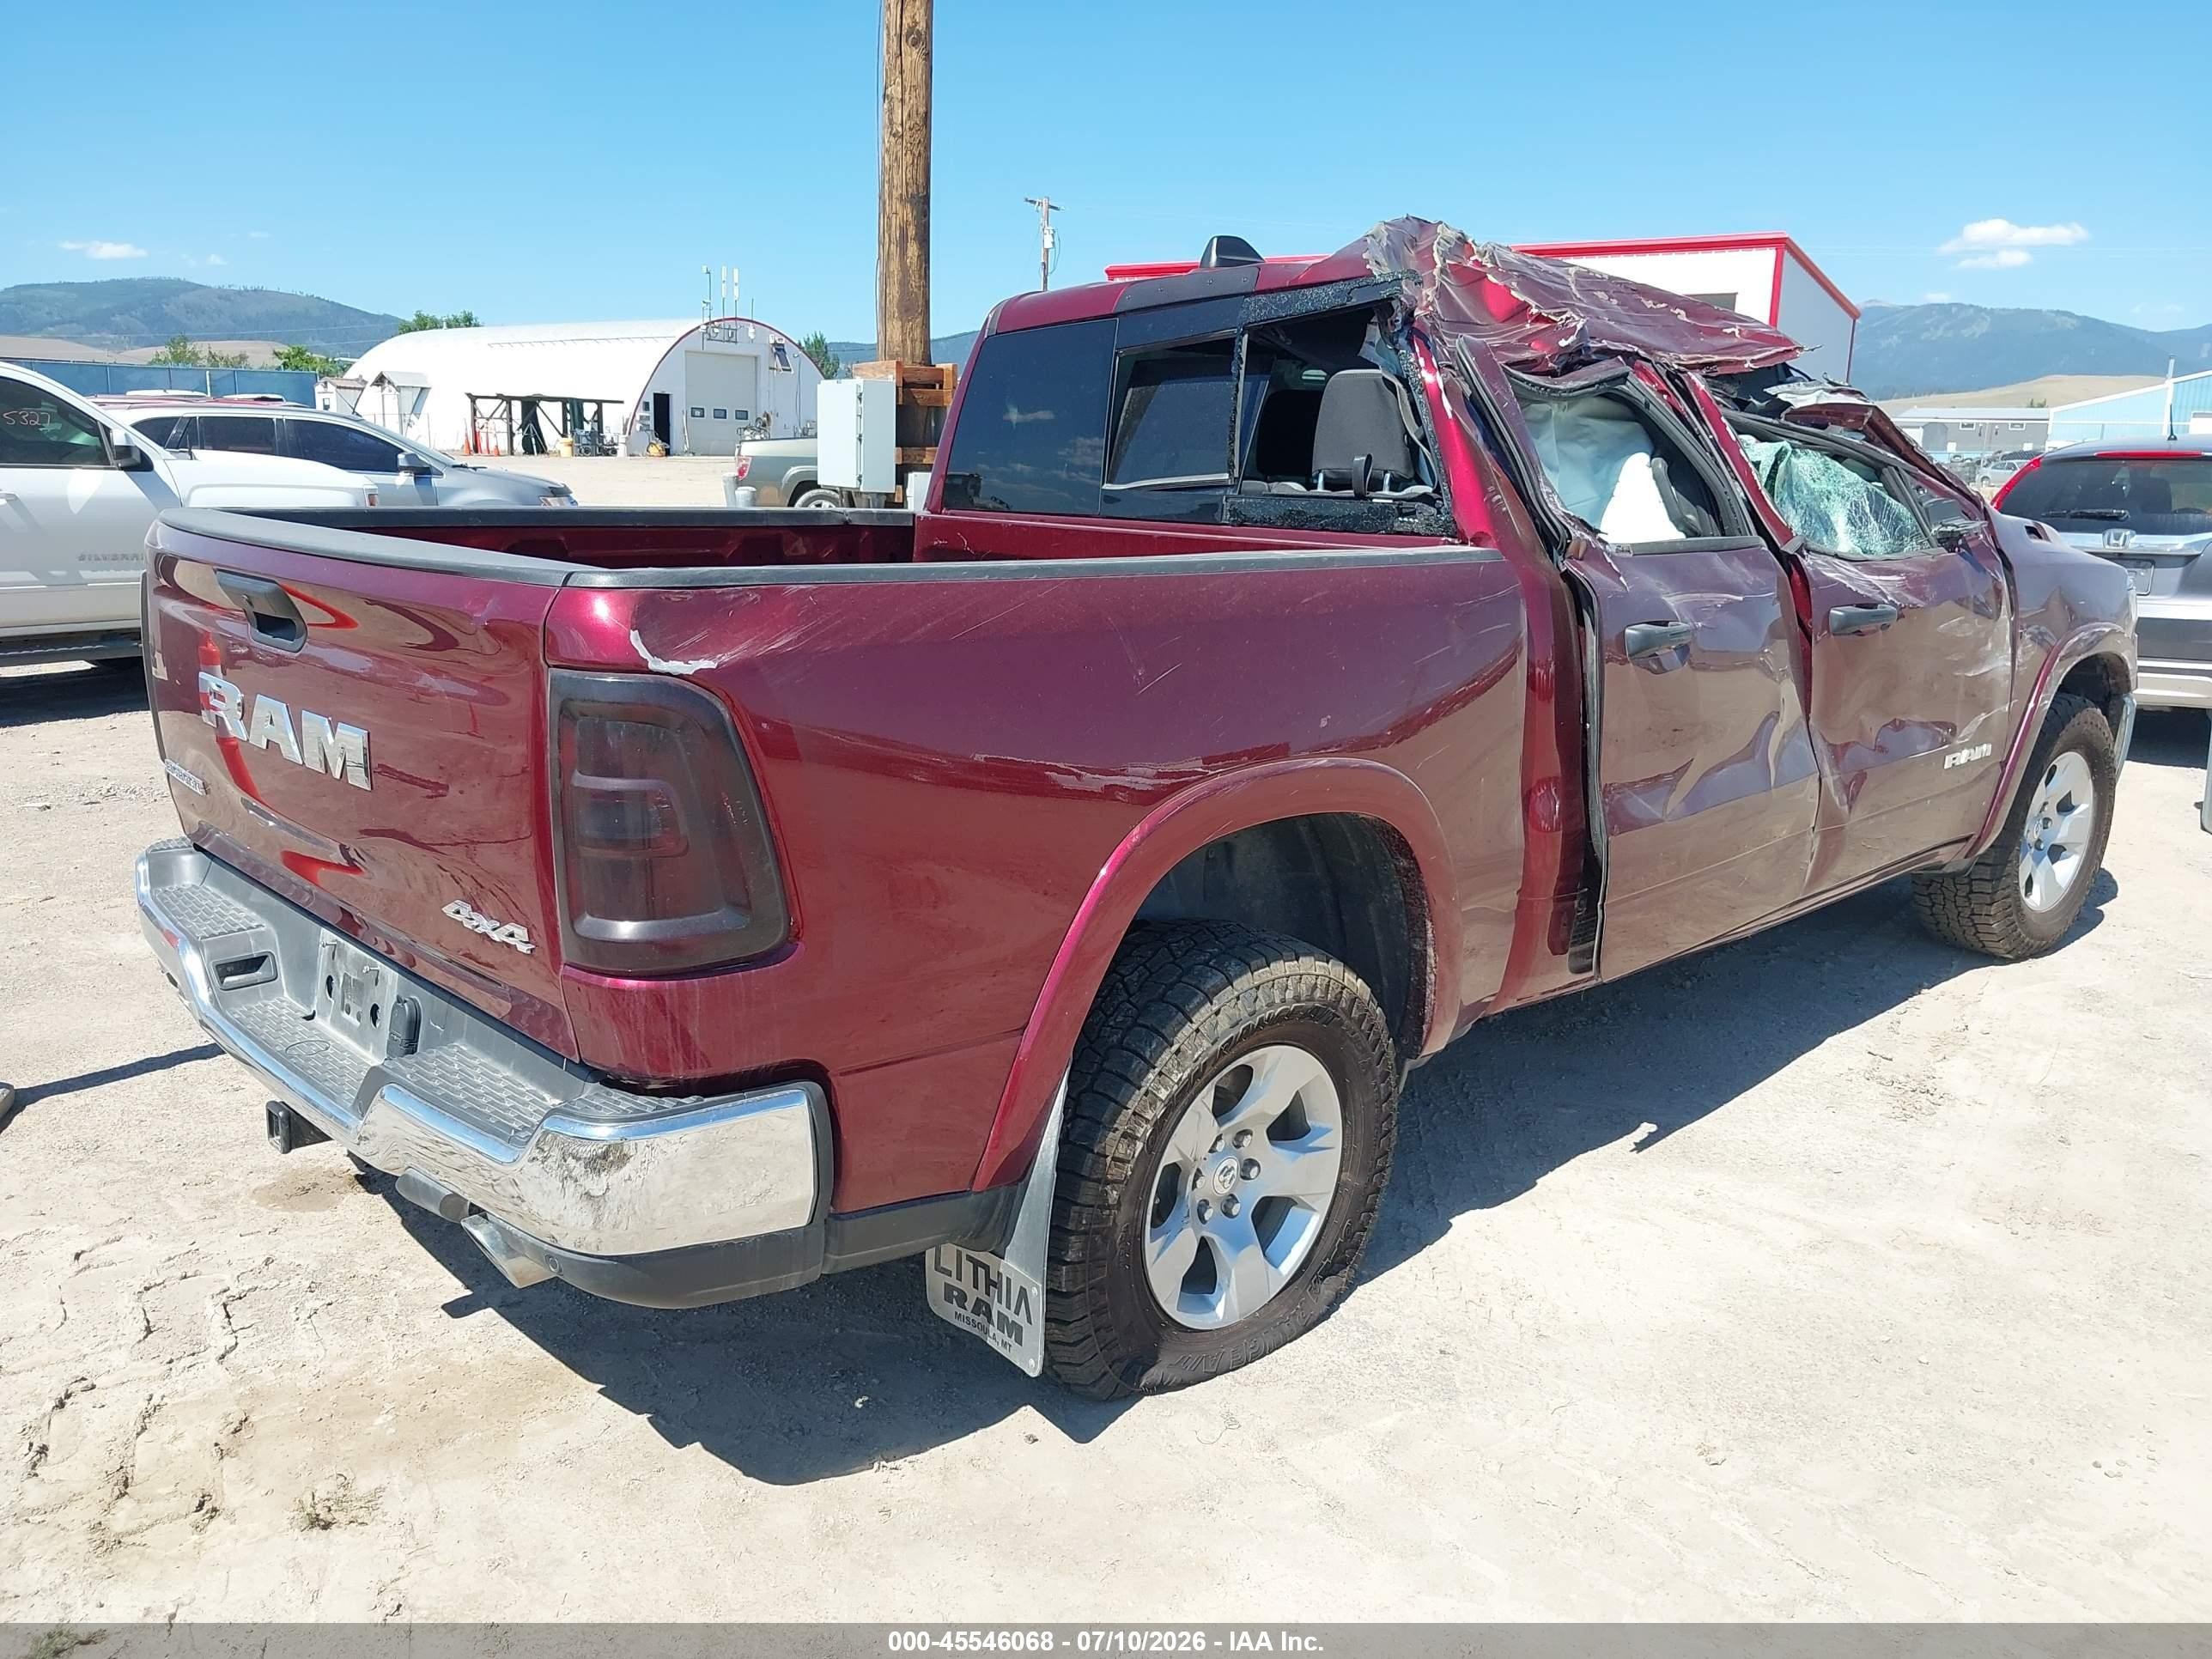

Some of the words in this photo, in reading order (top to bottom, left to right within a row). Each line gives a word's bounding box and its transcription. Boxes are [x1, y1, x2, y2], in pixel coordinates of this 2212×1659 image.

[3, 410, 50, 426] 5327
[198, 672, 373, 792] RAM
[1944, 744, 1992, 769] RAM
[934, 1244, 1033, 1326] LITHIA
[944, 1283, 1024, 1346] RAM
[954, 1310, 1000, 1346] MISSOULA,
[1000, 1338, 1013, 1354] MT
